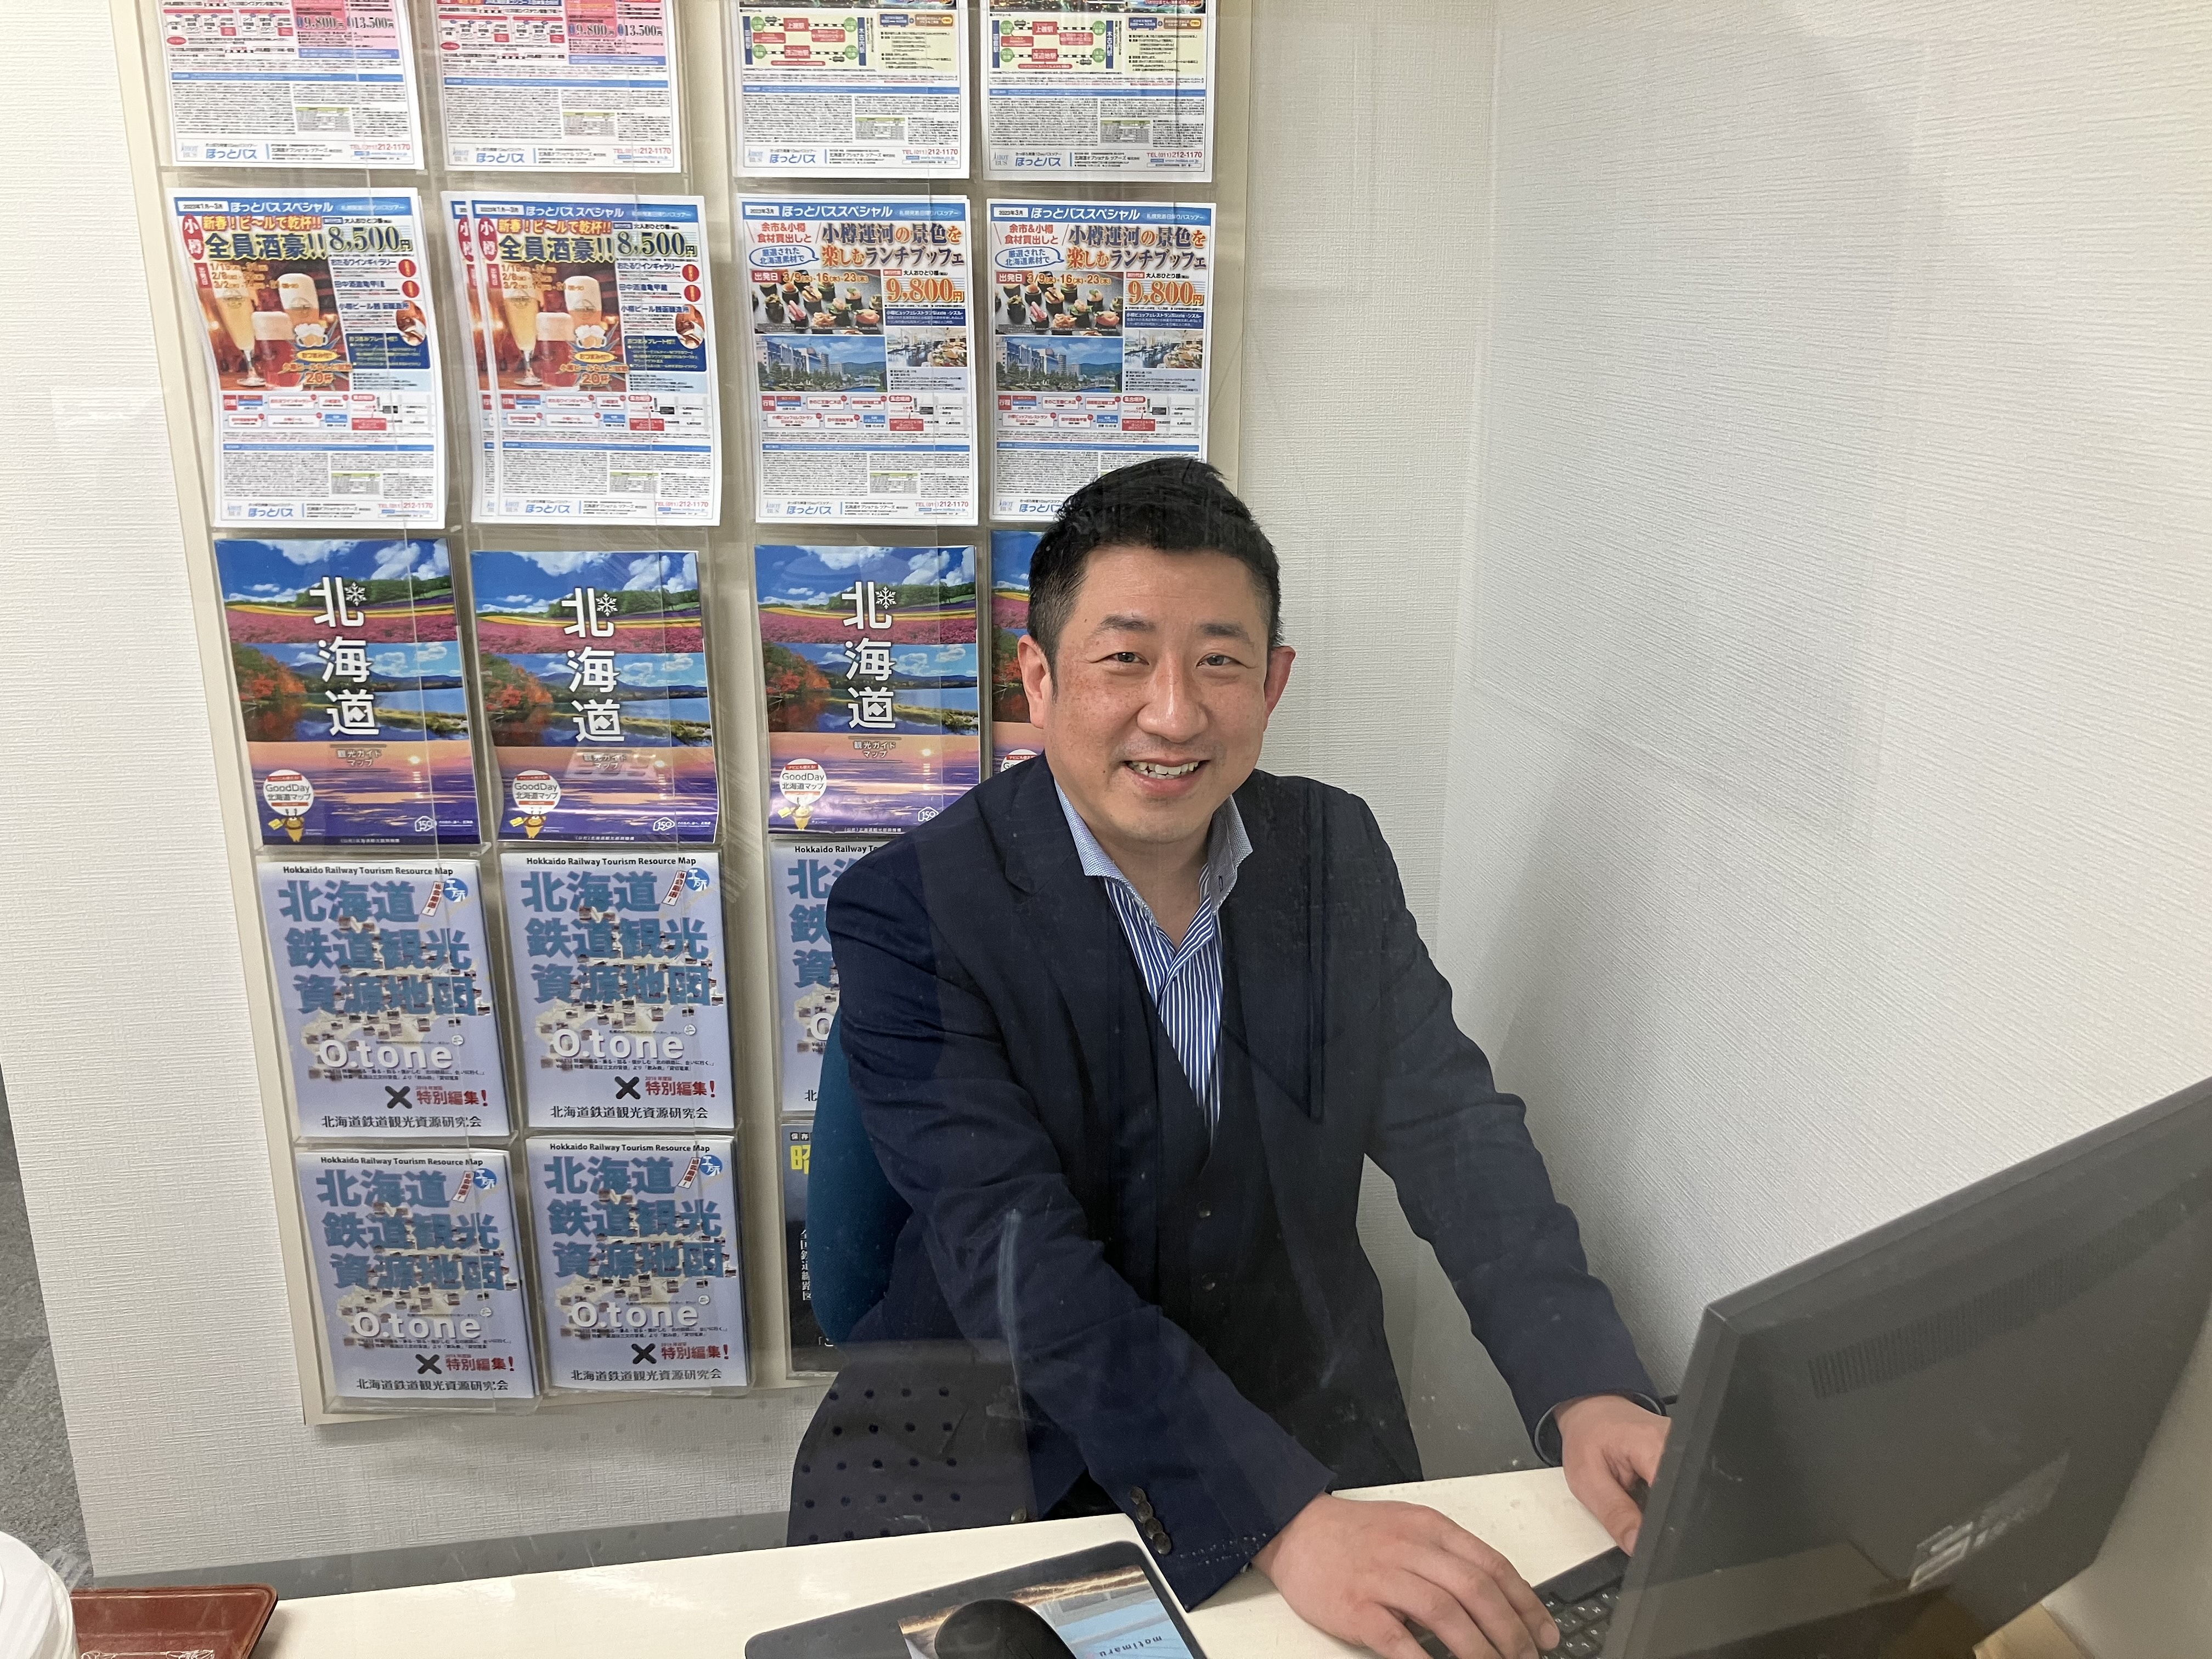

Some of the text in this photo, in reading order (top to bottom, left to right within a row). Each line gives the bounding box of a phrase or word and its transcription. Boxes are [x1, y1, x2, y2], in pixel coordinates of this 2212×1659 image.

[206, 149, 258, 160] ほっとバス
[476, 153, 525, 163] ほっとバス
[770, 154, 816, 163] ほっとバス
[1015, 157, 1061, 167] ほっとバス
[782, 206, 893, 217] ほっとバススペシャル
[1031, 207, 1141, 221] ほっとバススペシャル
[330, 226, 413, 252] 8,500円
[757, 234, 812, 244] 食材買出しと
[822, 223, 962, 244] 小樽運河の景色を
[1005, 235, 1059, 245] 食材買出しと
[1068, 225, 1206, 249] 小樽運河の景色を
[617, 231, 698, 257] 8,500円
[821, 246, 966, 268] 楽しむランチブッフェ
[1066, 246, 1207, 270] 楽しむランチブッフェ
[754, 272, 778, 281] 出発日
[998, 273, 1022, 282] 出発日
[886, 277, 965, 303] 9,800円
[1128, 280, 1204, 306] 9,800円
[248, 508, 294, 517] ほっとバス
[526, 504, 571, 514] ほっとバス
[786, 506, 832, 515] ほっとバス
[309, 576, 380, 735] 北海道
[842, 581, 896, 729] 北海道
[561, 588, 625, 742] 北海道
[854, 741, 895, 749] 観光ガイド
[347, 759, 373, 767] マップ
[782, 772, 825, 781] GoodDay
[265, 783, 310, 794] GoodDay
[515, 783, 558, 792] GoodDay
[836, 845, 867, 854] Railway
[568, 857, 601, 867] Railway
[678, 857, 696, 867] Map
[283, 866, 323, 874] Hokkaido
[325, 866, 358, 875] Railway
[521, 871, 659, 912] 北海道
[278, 879, 420, 922] 北海道
[524, 917, 709, 960] 鉄道観光
[285, 927, 472, 970] 鉄道観光
[552, 1028, 685, 1059] O.tone
[318, 1039, 453, 1069] O.tone
[550, 1107, 709, 1120] 北海道鉄道観光資源研究会
[321, 1115, 482, 1128] 北海道鉄道観光資源研究会
[693, 1144, 710, 1153] Map
[360, 1157, 392, 1166] Railway
[544, 1156, 675, 1194] 北海道
[316, 1169, 449, 1207] 北海道
[547, 1199, 721, 1237] 鉄道観光
[322, 1211, 500, 1249] 鉄道観光
[571, 1301, 699, 1327] O.tone
[354, 1312, 482, 1339] O.tone
[571, 1368, 722, 1382] 北海道鉄道観光資源研究会
[357, 1379, 509, 1391] 北海道鉄道観光資源研究会
[1099, 1635, 1162, 1657] motimaru
